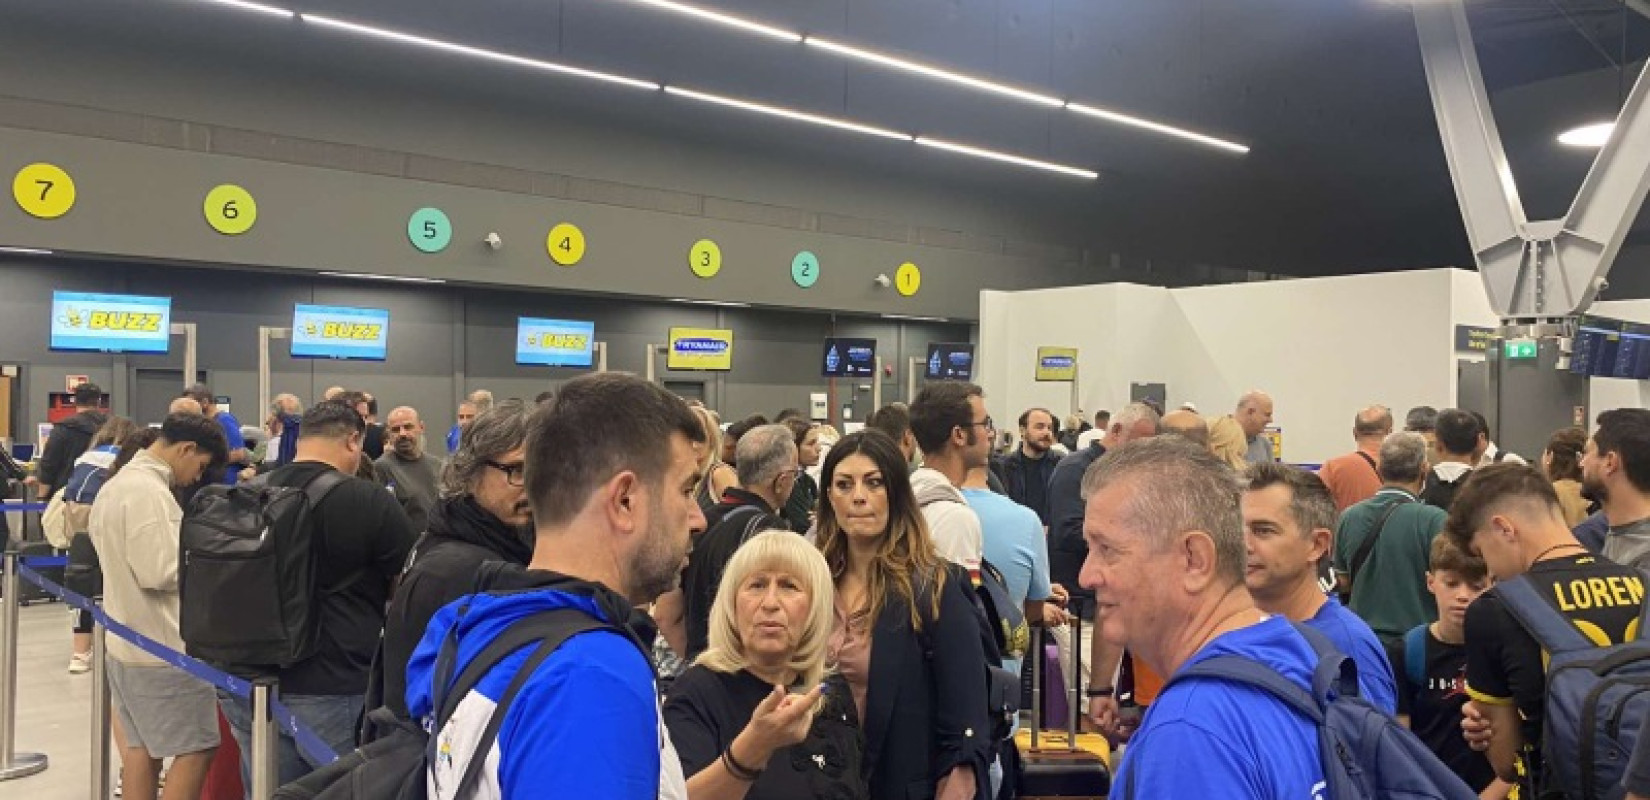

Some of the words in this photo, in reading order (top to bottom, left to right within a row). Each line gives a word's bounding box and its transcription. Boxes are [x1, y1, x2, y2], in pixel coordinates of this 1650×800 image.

[36, 180, 54, 201] 7
[222, 201, 238, 219] 6
[424, 221, 436, 240] 5
[558, 236, 572, 252] 4
[701, 251, 711, 267] 3
[801, 262, 810, 277] 2
[89, 311, 162, 332] BUZZ
[323, 322, 381, 340] BUZZ
[542, 332, 587, 351] BUZZ
[1553, 576, 1644, 611] LOREN
